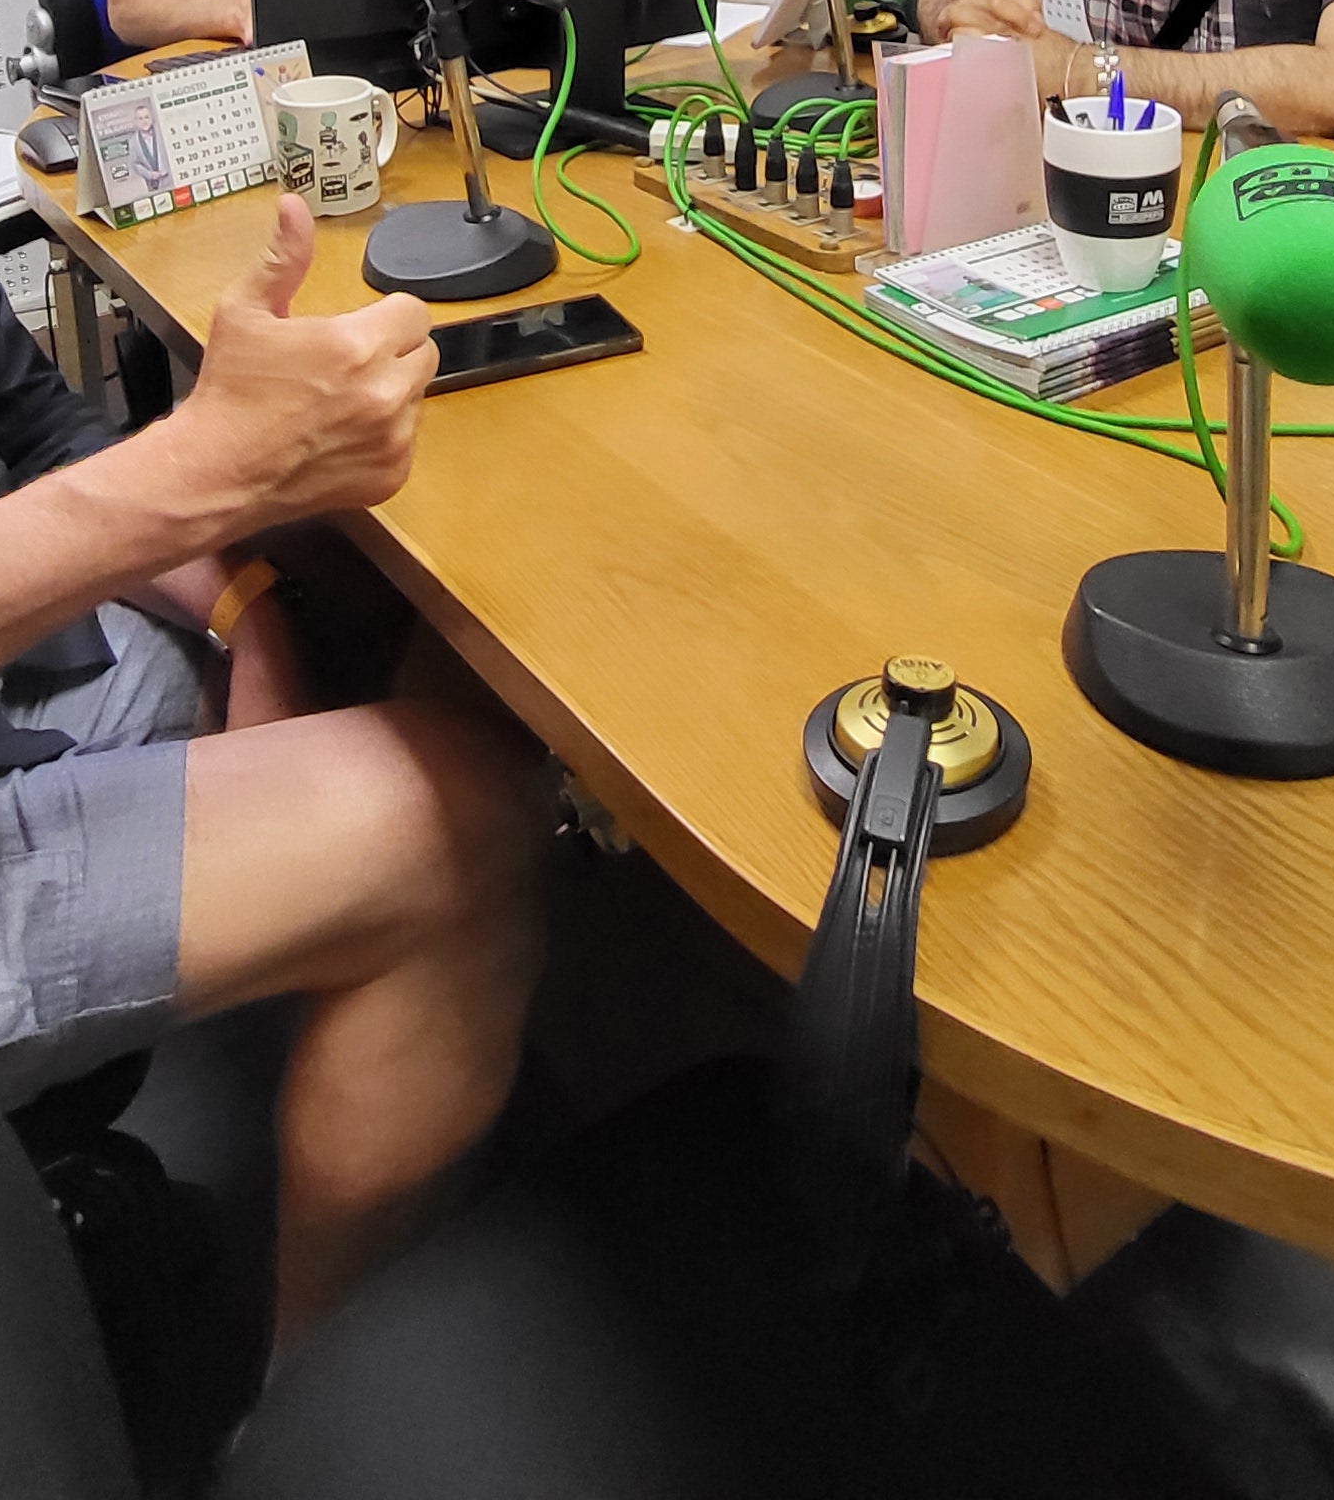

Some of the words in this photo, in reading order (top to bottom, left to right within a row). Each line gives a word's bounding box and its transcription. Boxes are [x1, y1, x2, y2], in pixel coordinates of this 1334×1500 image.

[172, 81, 207, 97] AGOSTO
[232, 110, 241, 118] 10
[173, 142, 181, 150] 12
[211, 131, 219, 139] 15
[247, 121, 256, 129] 18
[176, 156, 184, 164] 19
[189, 153, 198, 161] 20
[202, 150, 210, 158] 21
[214, 146, 222, 154] 22
[227, 142, 235, 150] 23
[239, 139, 247, 147] 24
[179, 171, 189, 180] 26
[192, 168, 201, 176] 27
[205, 164, 214, 172] 28
[218, 160, 226, 168] 29
[229, 157, 238, 165] 30
[242, 153, 250, 161] 31
